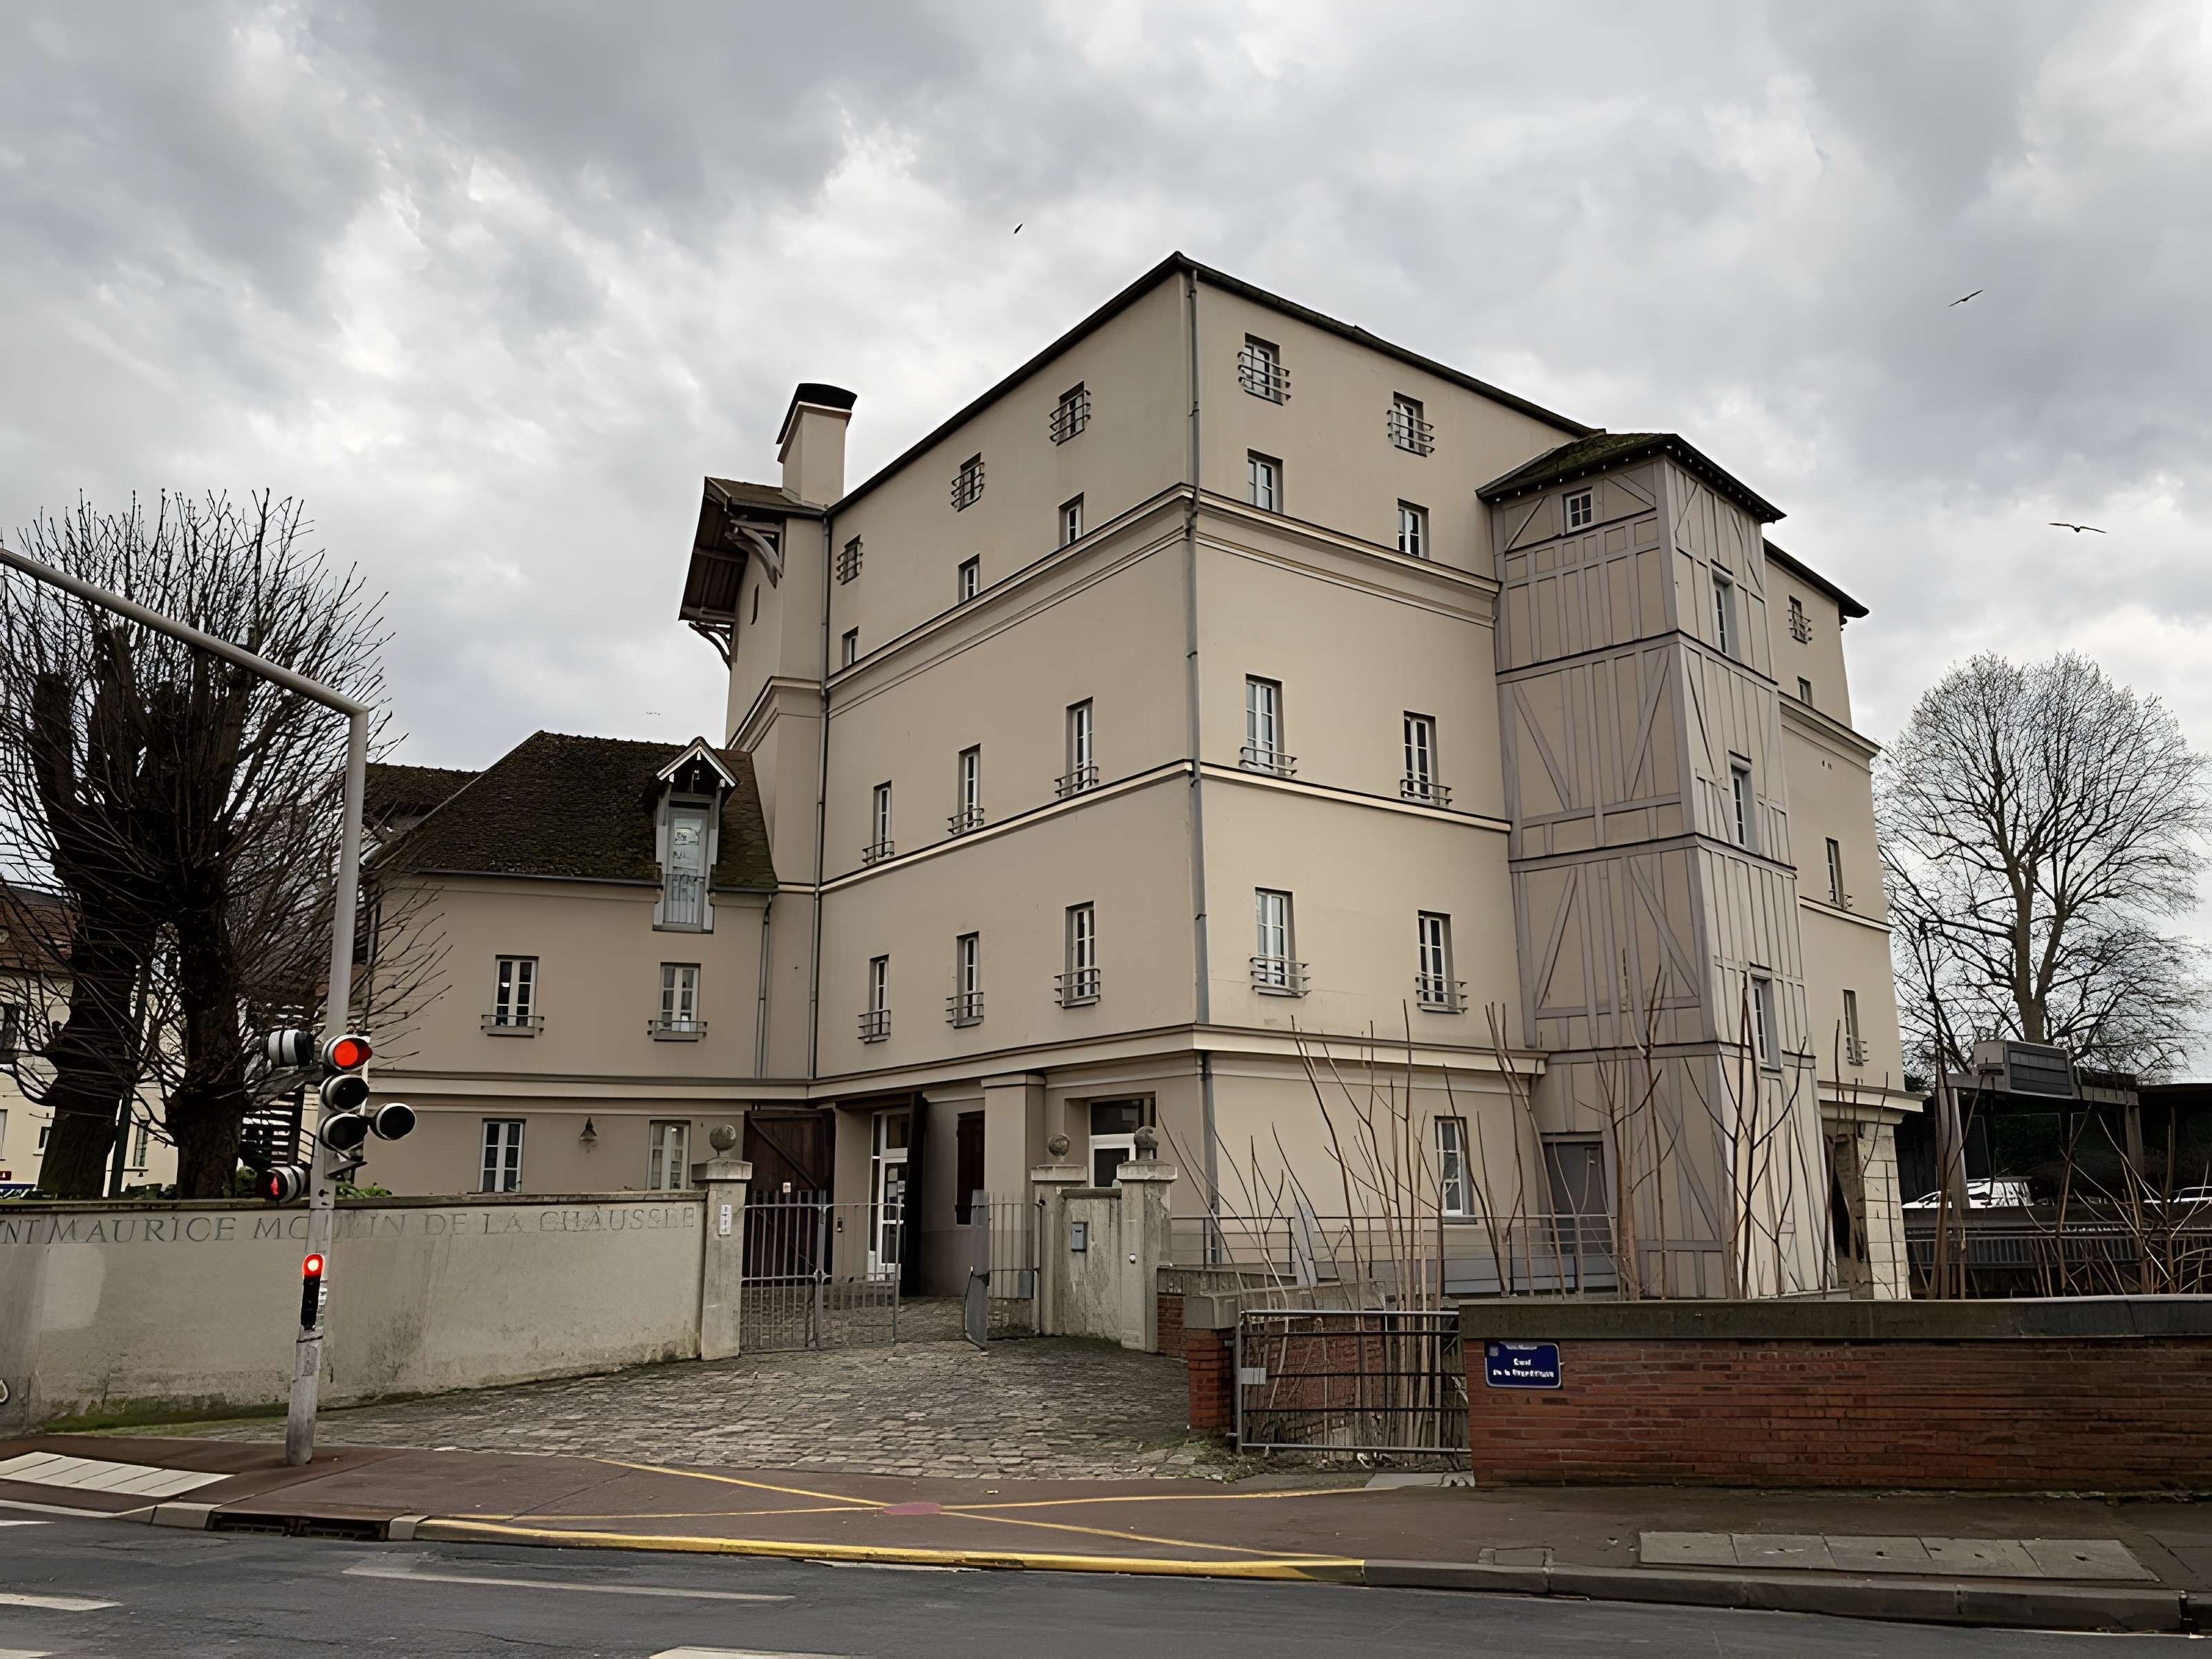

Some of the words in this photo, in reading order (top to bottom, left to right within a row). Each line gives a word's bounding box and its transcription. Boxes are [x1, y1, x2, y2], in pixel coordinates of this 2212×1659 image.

[45, 1217, 236, 1244] MAURICE
[424, 1213, 467, 1235] DE
[482, 1213, 527, 1235] LA
